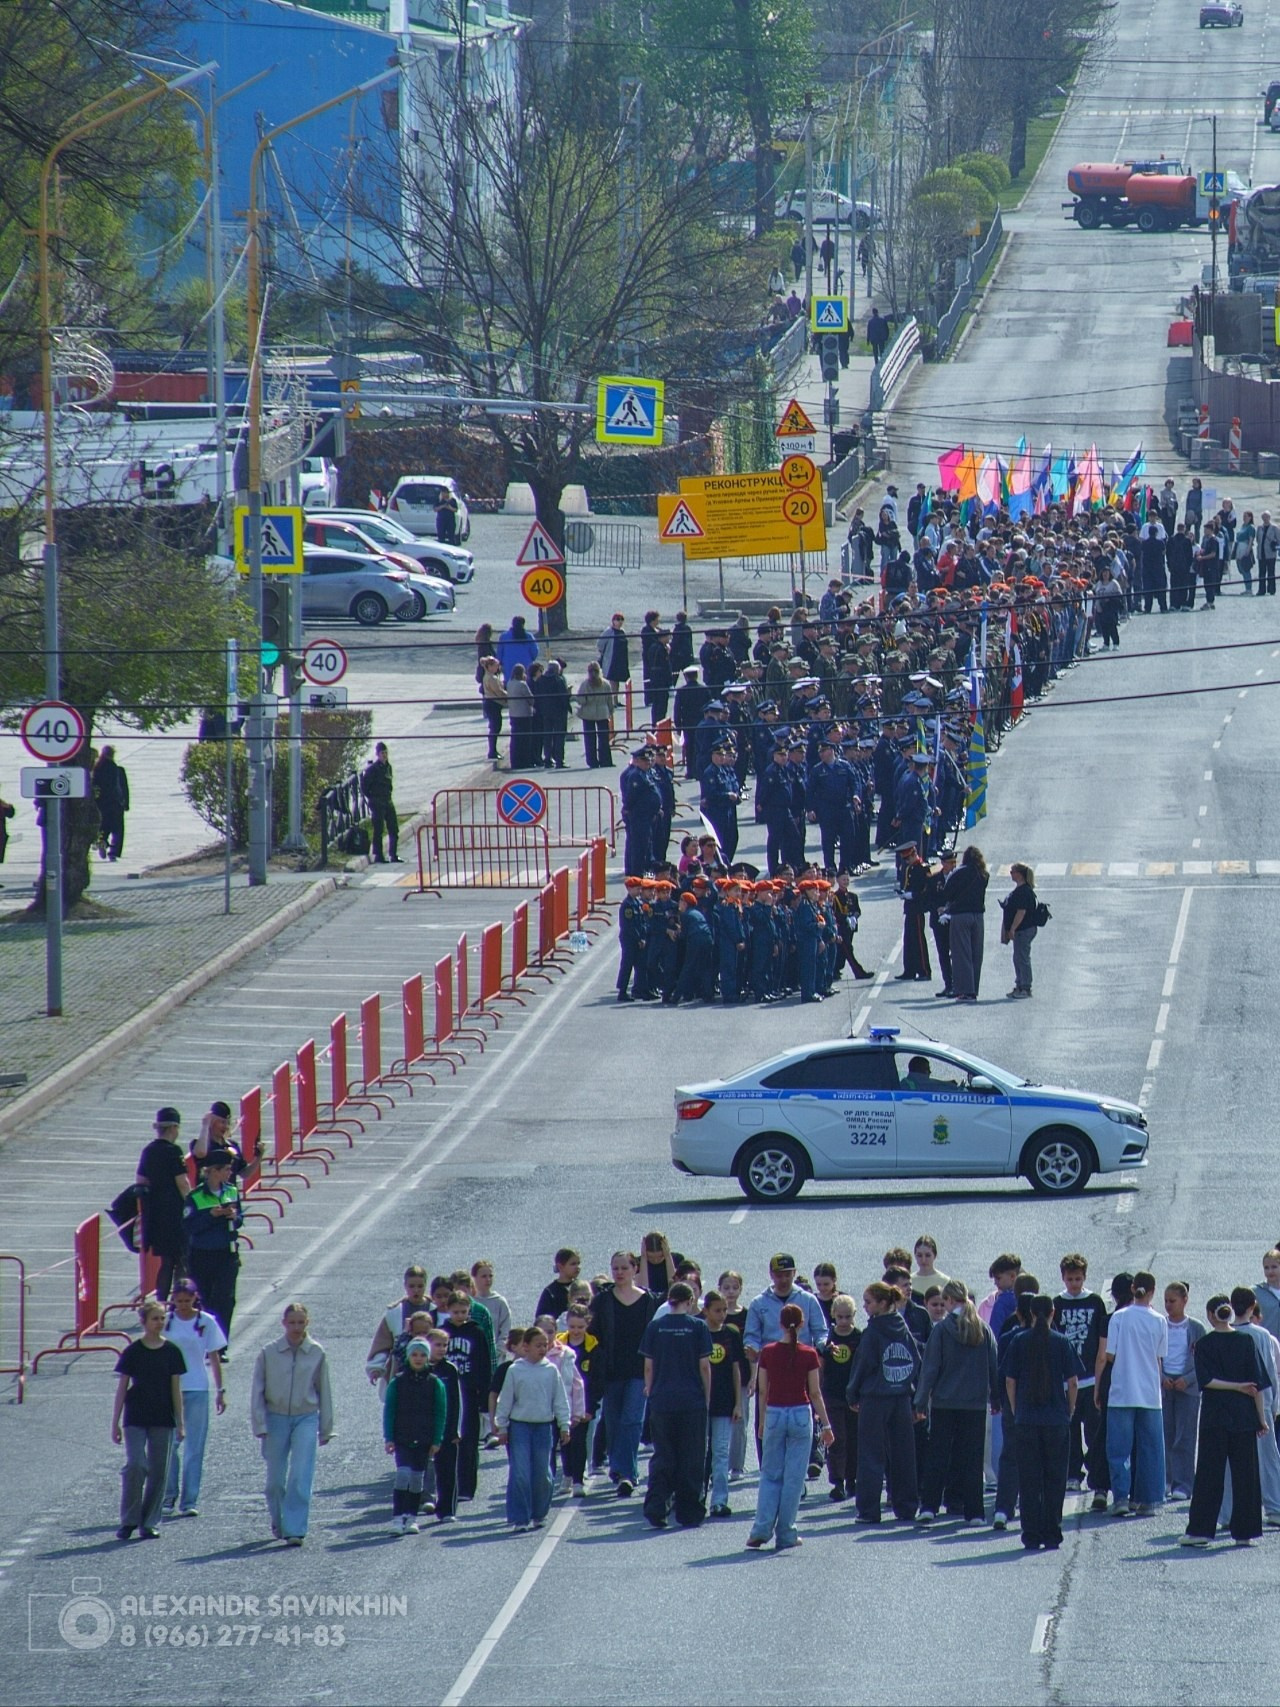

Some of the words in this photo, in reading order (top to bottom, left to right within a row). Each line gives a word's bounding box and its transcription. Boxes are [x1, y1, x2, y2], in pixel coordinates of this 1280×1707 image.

[786, 442, 800, 450] 100
[704, 476, 786, 491] РЕКОНСТРУКЦ
[790, 501, 809, 515] 20
[530, 579, 553, 595] 40
[311, 653, 337, 671] 40
[35, 720, 69, 743] 40
[932, 1094, 995, 1104] ПОЛИЦИЯ
[850, 1132, 887, 1146] 3224
[1060, 1309, 1094, 1325] JUST
